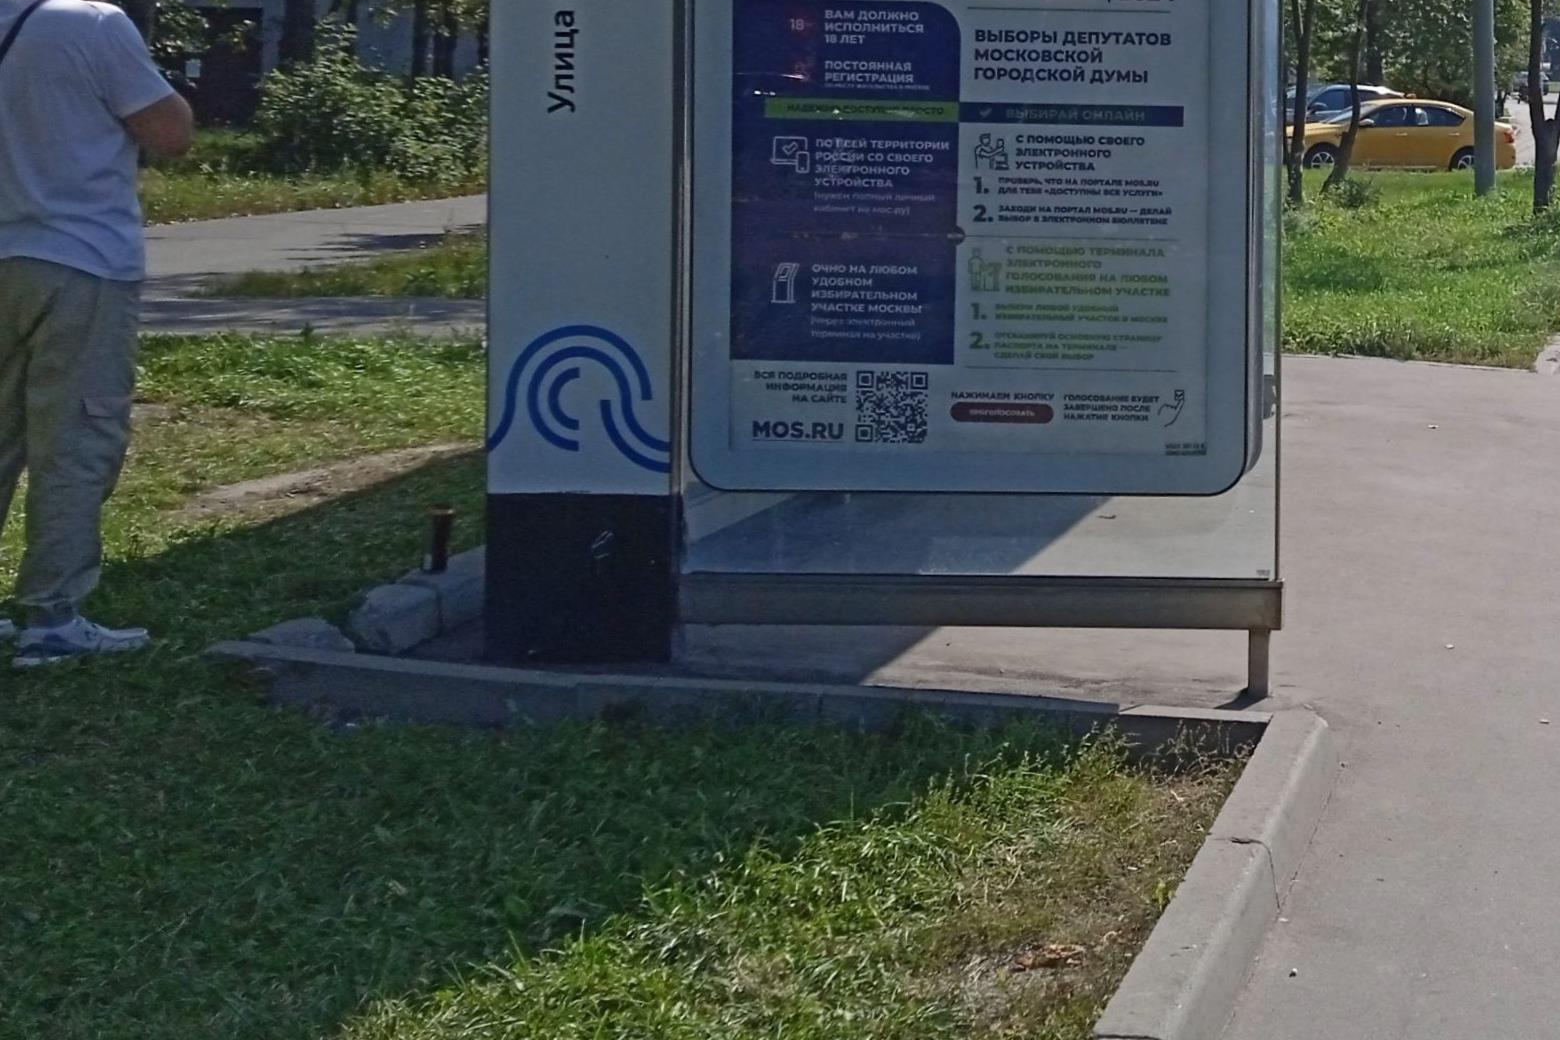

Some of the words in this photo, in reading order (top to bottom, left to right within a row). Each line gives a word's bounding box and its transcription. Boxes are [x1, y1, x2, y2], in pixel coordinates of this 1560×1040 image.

[825, 9, 855, 20] ВАМ
[857, 10, 919, 22] ДОЛЖНО
[825, 22, 924, 34] ИСПОЛНИТЬСЯ
[825, 34, 836, 44] 18
[839, 34, 866, 45] ЛЕТ
[975, 29, 1057, 43] ВЫБОРЫ
[1062, 31, 1172, 46] ДЕПУТАТОВ
[974, 47, 1103, 63] МОСКОВСКОЙ
[548, 9, 579, 113] Улица
[825, 60, 912, 72] ПОСТОЯННАЯ
[825, 72, 914, 84] РЕГИСТРАЦИЯ
[974, 66, 1085, 83] ГОРОДСКОЙ
[1089, 69, 1148, 84] ДУМЫ
[1006, 108, 1079, 120] ВЫБИРАЙ
[1083, 108, 1145, 121] ОНЛАЙН
[816, 138, 833, 148] ПО
[870, 139, 950, 150] ТЕРРИТОРИИ
[1016, 135, 1024, 143] С
[1027, 135, 1095, 146] ПОМОЩЬЮ
[1098, 136, 1145, 146] СВОЕГО
[815, 152, 864, 162] РОССИИ
[867, 153, 884, 162] СО
[887, 153, 934, 163] СВОЕГО
[1016, 148, 1111, 158] ЭЛЕКТРОННОГО
[815, 164, 910, 175] ЭЛЕКТРОННОГО
[1015, 161, 1095, 171] УСТРОЙСТВА
[814, 176, 893, 188] УСТРОЙСТВА
[973, 176, 989, 194] 1.
[973, 204, 994, 222] 2.
[1017, 246, 1085, 256] ПОМОЩЬЮ
[812, 264, 846, 273] ОЧНО
[849, 264, 866, 274] НА
[869, 265, 918, 275] ЛЮБОМ
[1006, 259, 1101, 269] ЭЛЕКТРОННОГО
[811, 277, 873, 288] УДОБНОМ
[1099, 274, 1116, 282] НА
[811, 290, 918, 301] ИЗБИРАТЕЛЬНОМ
[1006, 285, 1113, 295] ИЗБИРАТЕЛЬНОМ
[811, 303, 865, 313] УЧАСТКЕ
[868, 304, 922, 314] МОСКВЫ
[970, 302, 987, 320] 1.
[969, 331, 990, 349] 2.
[754, 371, 775, 380] ВСЯ
[778, 371, 848, 381] ПОДРОБНАЯ
[766, 382, 848, 393] ИНФОРМАЦИЯ
[792, 394, 809, 403] НА
[811, 393, 848, 404] САЙТЕ
[752, 420, 844, 439] MOS.RU
